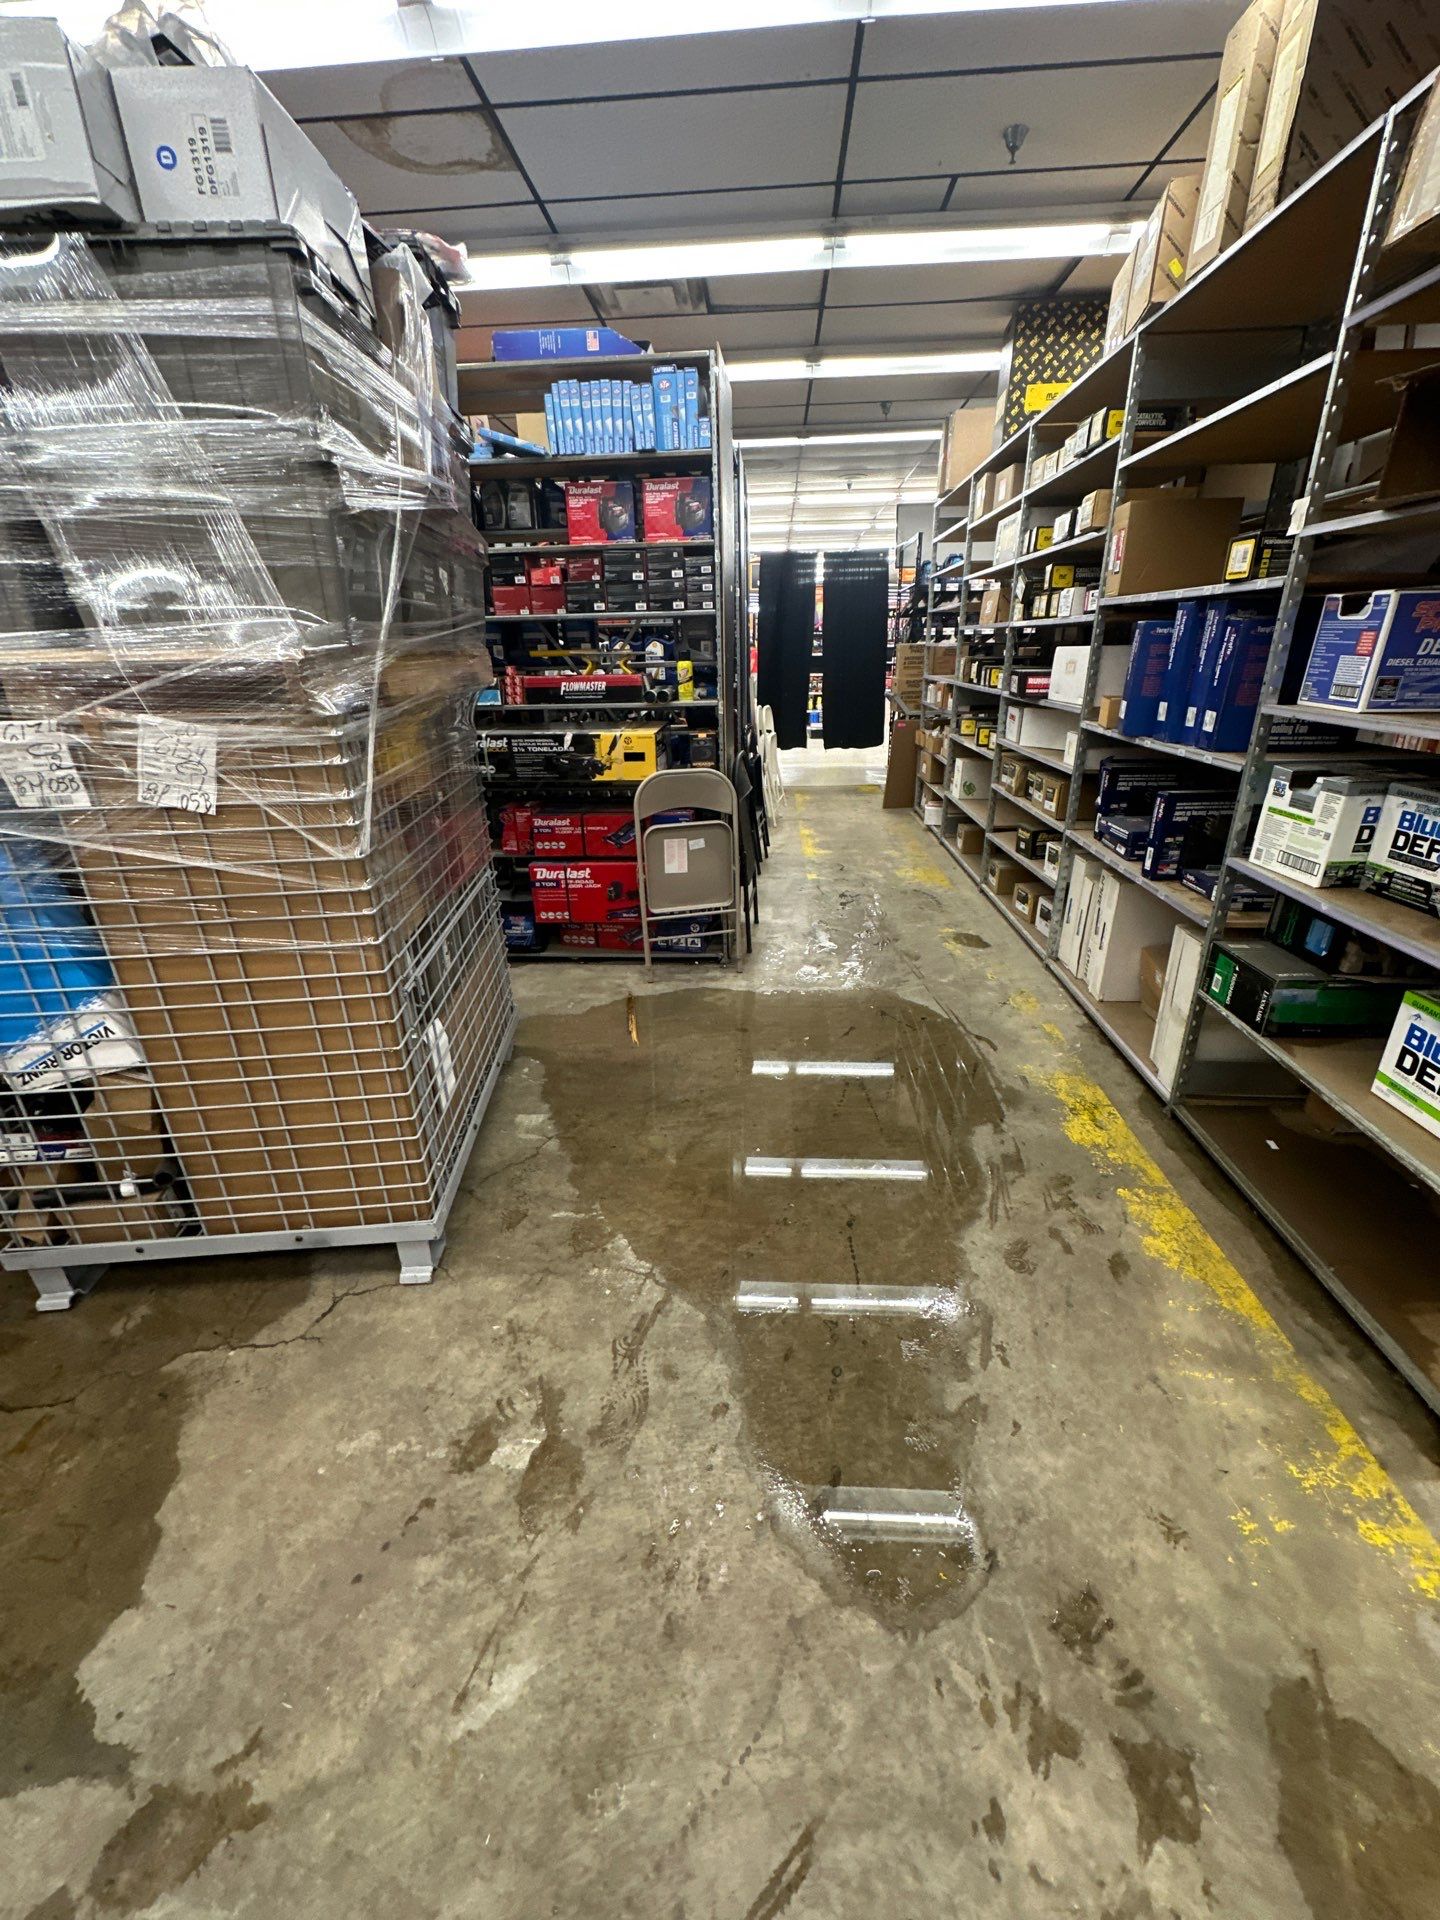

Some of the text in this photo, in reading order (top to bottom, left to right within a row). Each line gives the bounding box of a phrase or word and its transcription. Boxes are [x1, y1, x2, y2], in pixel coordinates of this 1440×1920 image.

[187, 137, 206, 195] FG1319
[198, 126, 218, 195] DFG1319
[568, 485, 602, 494] Duralast
[645, 481, 679, 490] Duralast
[1416, 637, 1440, 656] DE
[1386, 658, 1414, 667] DIESEL
[560, 681, 607, 696] FLOWMASTER
[1271, 724, 1293, 735] ooling
[475, 737, 508, 748] ralast
[532, 818, 570, 826] Duralast
[1397, 809, 1440, 838] Blu
[532, 867, 592, 879] Duralast
[1255, 990, 1270, 1022] LEXMARK
[1411, 1000, 1440, 1020] GUARAN
[60, 1025, 115, 1061] VICTOR
[17, 1055, 60, 1086] REINZ
[1395, 1045, 1440, 1093] DE
